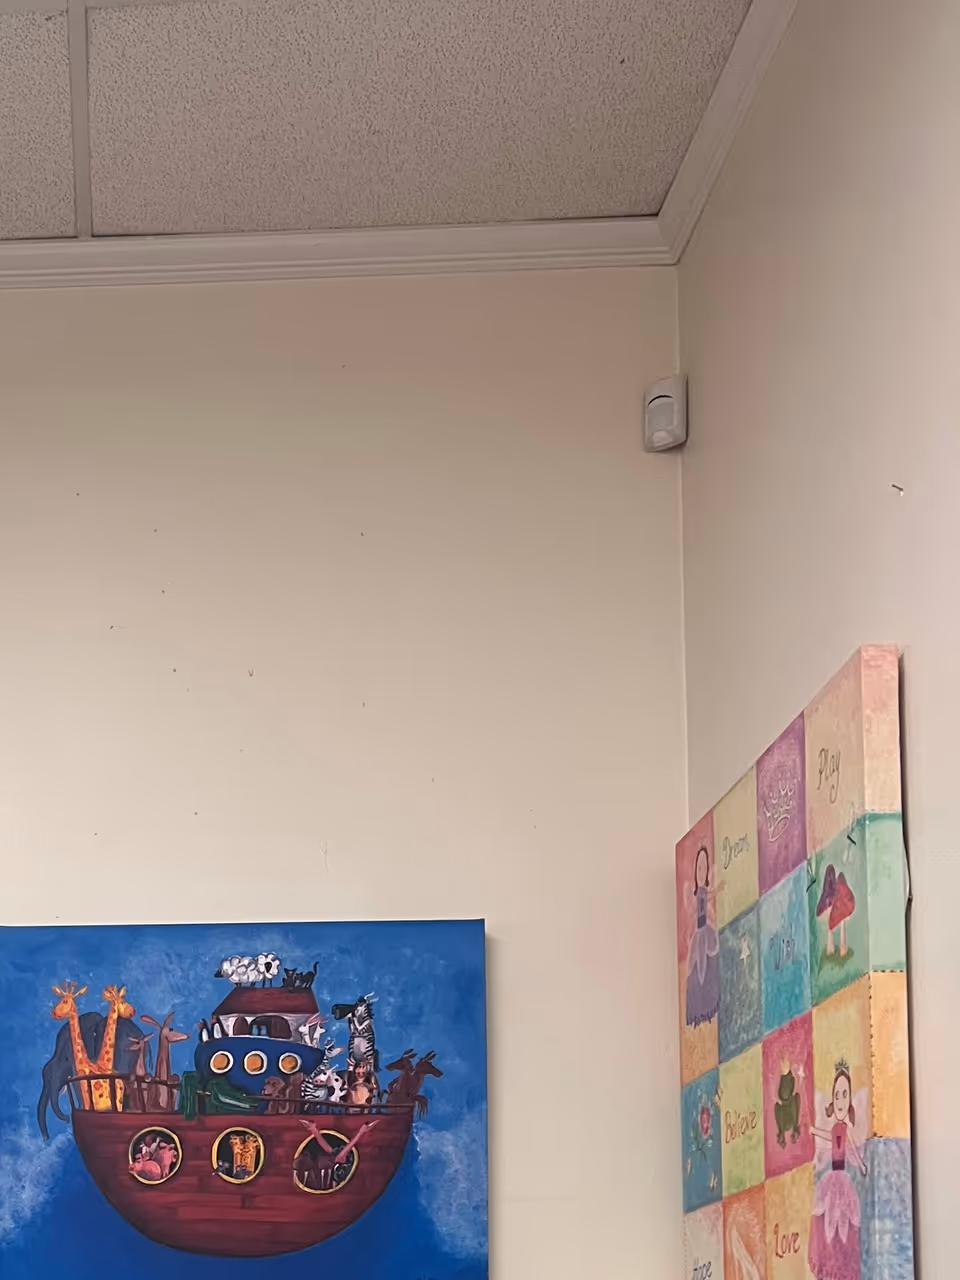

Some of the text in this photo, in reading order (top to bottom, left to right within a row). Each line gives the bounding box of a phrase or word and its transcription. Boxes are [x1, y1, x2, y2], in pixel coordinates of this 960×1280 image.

[817, 748, 841, 804] Play
[724, 1111, 757, 1143] Believe
[774, 1223, 800, 1258] Love
